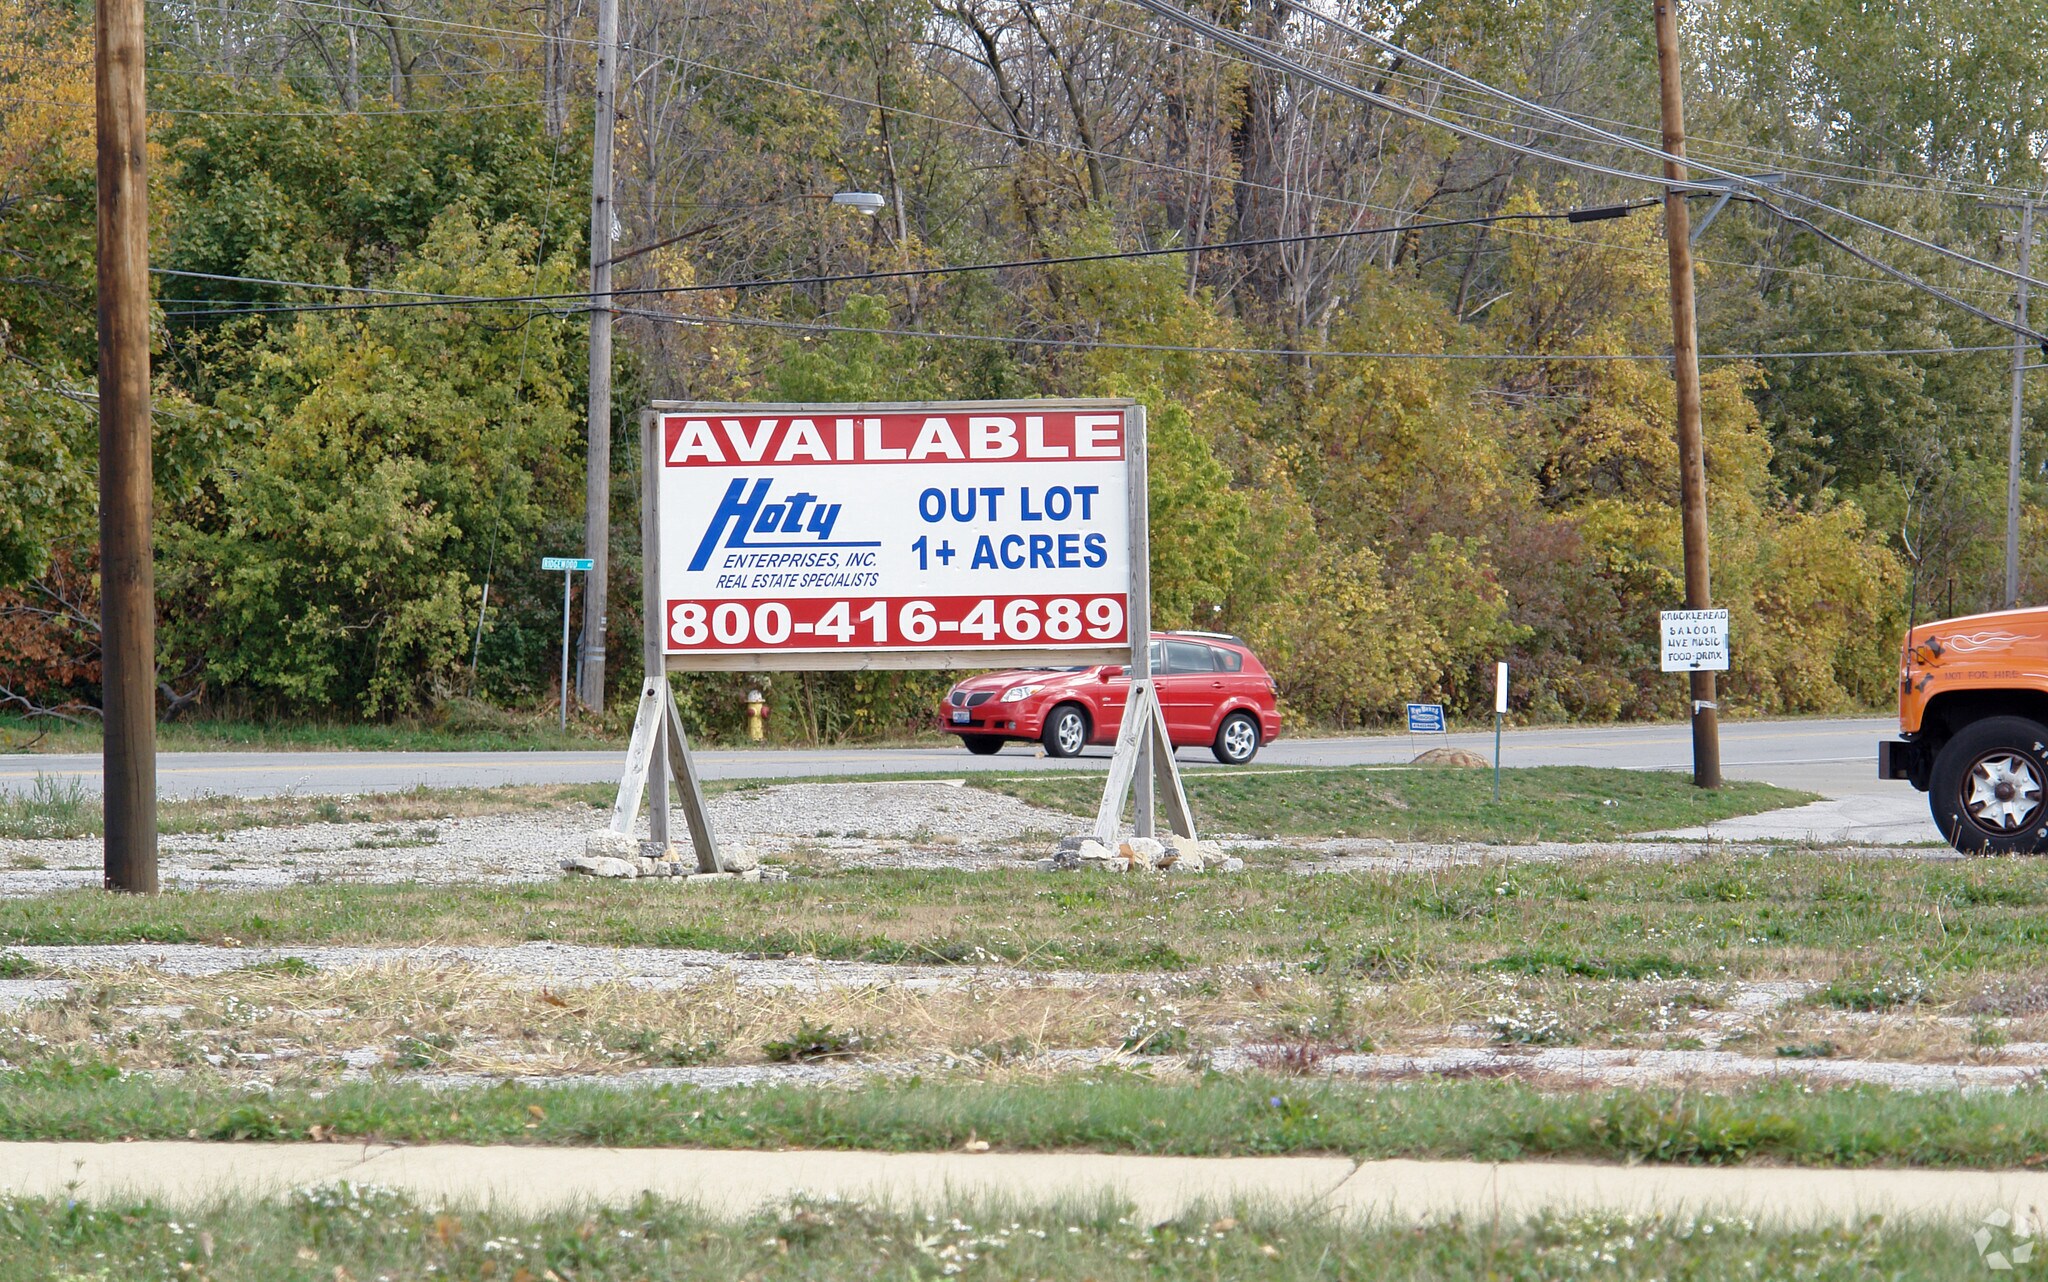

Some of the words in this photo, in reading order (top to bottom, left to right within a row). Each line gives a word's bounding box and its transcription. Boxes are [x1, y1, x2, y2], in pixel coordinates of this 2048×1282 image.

[668, 415, 1122, 463] AVAILABLE
[918, 486, 1005, 523] OUT
[1020, 485, 1100, 521] LOT
[687, 477, 842, 572] Hoty
[722, 553, 840, 568] ENTERPRISES,
[845, 552, 877, 567] INC.
[911, 535, 956, 571] 1+
[971, 532, 1108, 570] ACRES
[715, 573, 750, 589] REAL
[751, 573, 798, 589] ESTATE
[799, 572, 879, 588] SPECIALISTS
[670, 598, 1124, 645] 800-416-4689
[1669, 625, 1717, 635] SALOON
[1668, 639, 1688, 647] LIVE
[1692, 637, 1720, 646] MUSIC
[1944, 672, 1963, 680] NOT
[1968, 671, 1989, 680] FOR
[1994, 670, 2018, 679] HIRE
